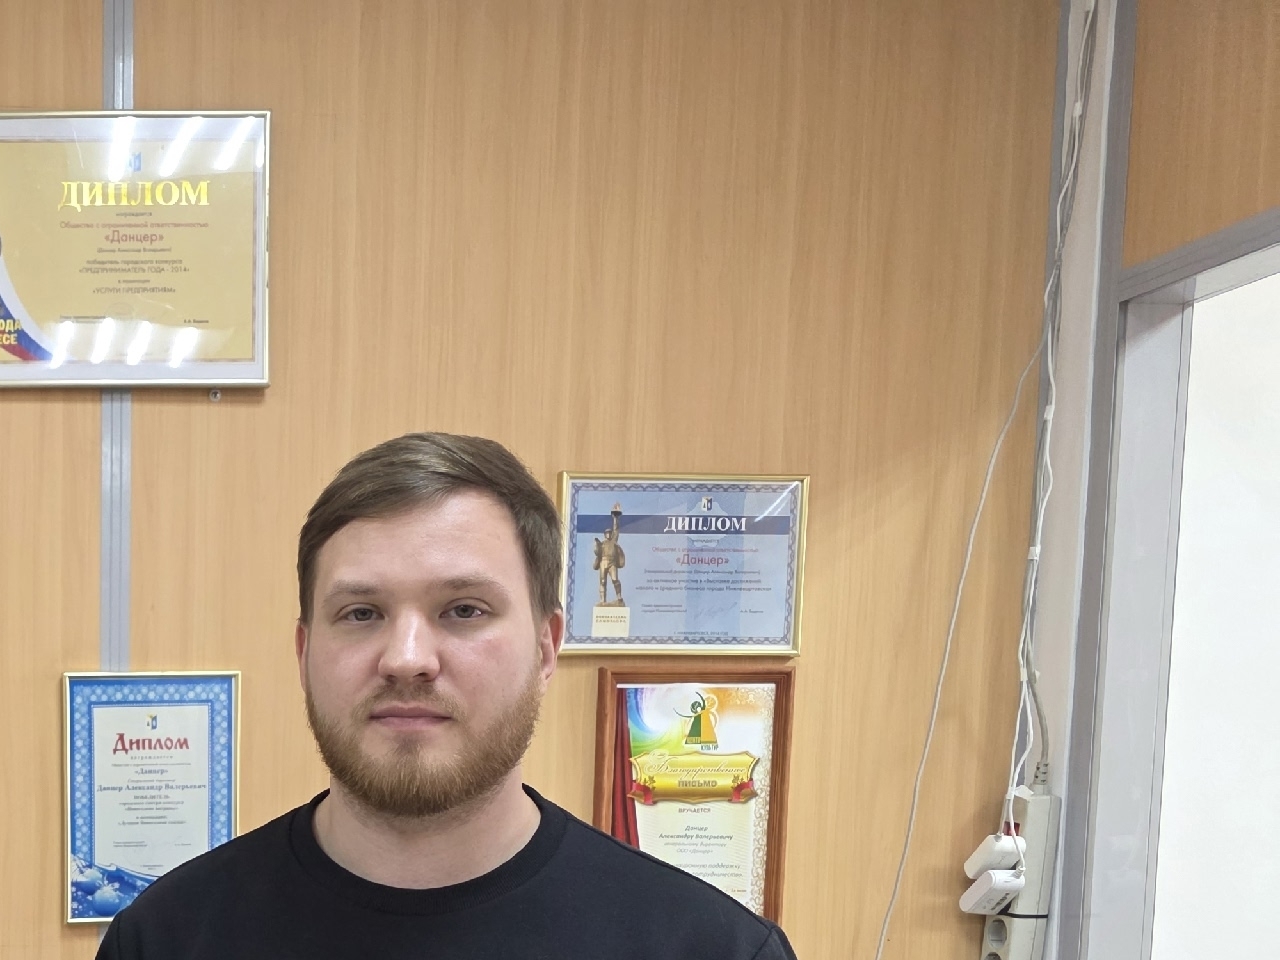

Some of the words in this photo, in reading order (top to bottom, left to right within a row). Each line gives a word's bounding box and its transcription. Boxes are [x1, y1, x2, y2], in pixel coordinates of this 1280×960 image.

[58, 180, 211, 213] ДИПЛОМ
[105, 230, 164, 245] «Данцер»
[664, 517, 748, 533] ДИПЛОМ
[676, 554, 730, 568] «Данцер»
[113, 733, 190, 756] Диплом
[678, 780, 718, 788] ПИСЬМО
